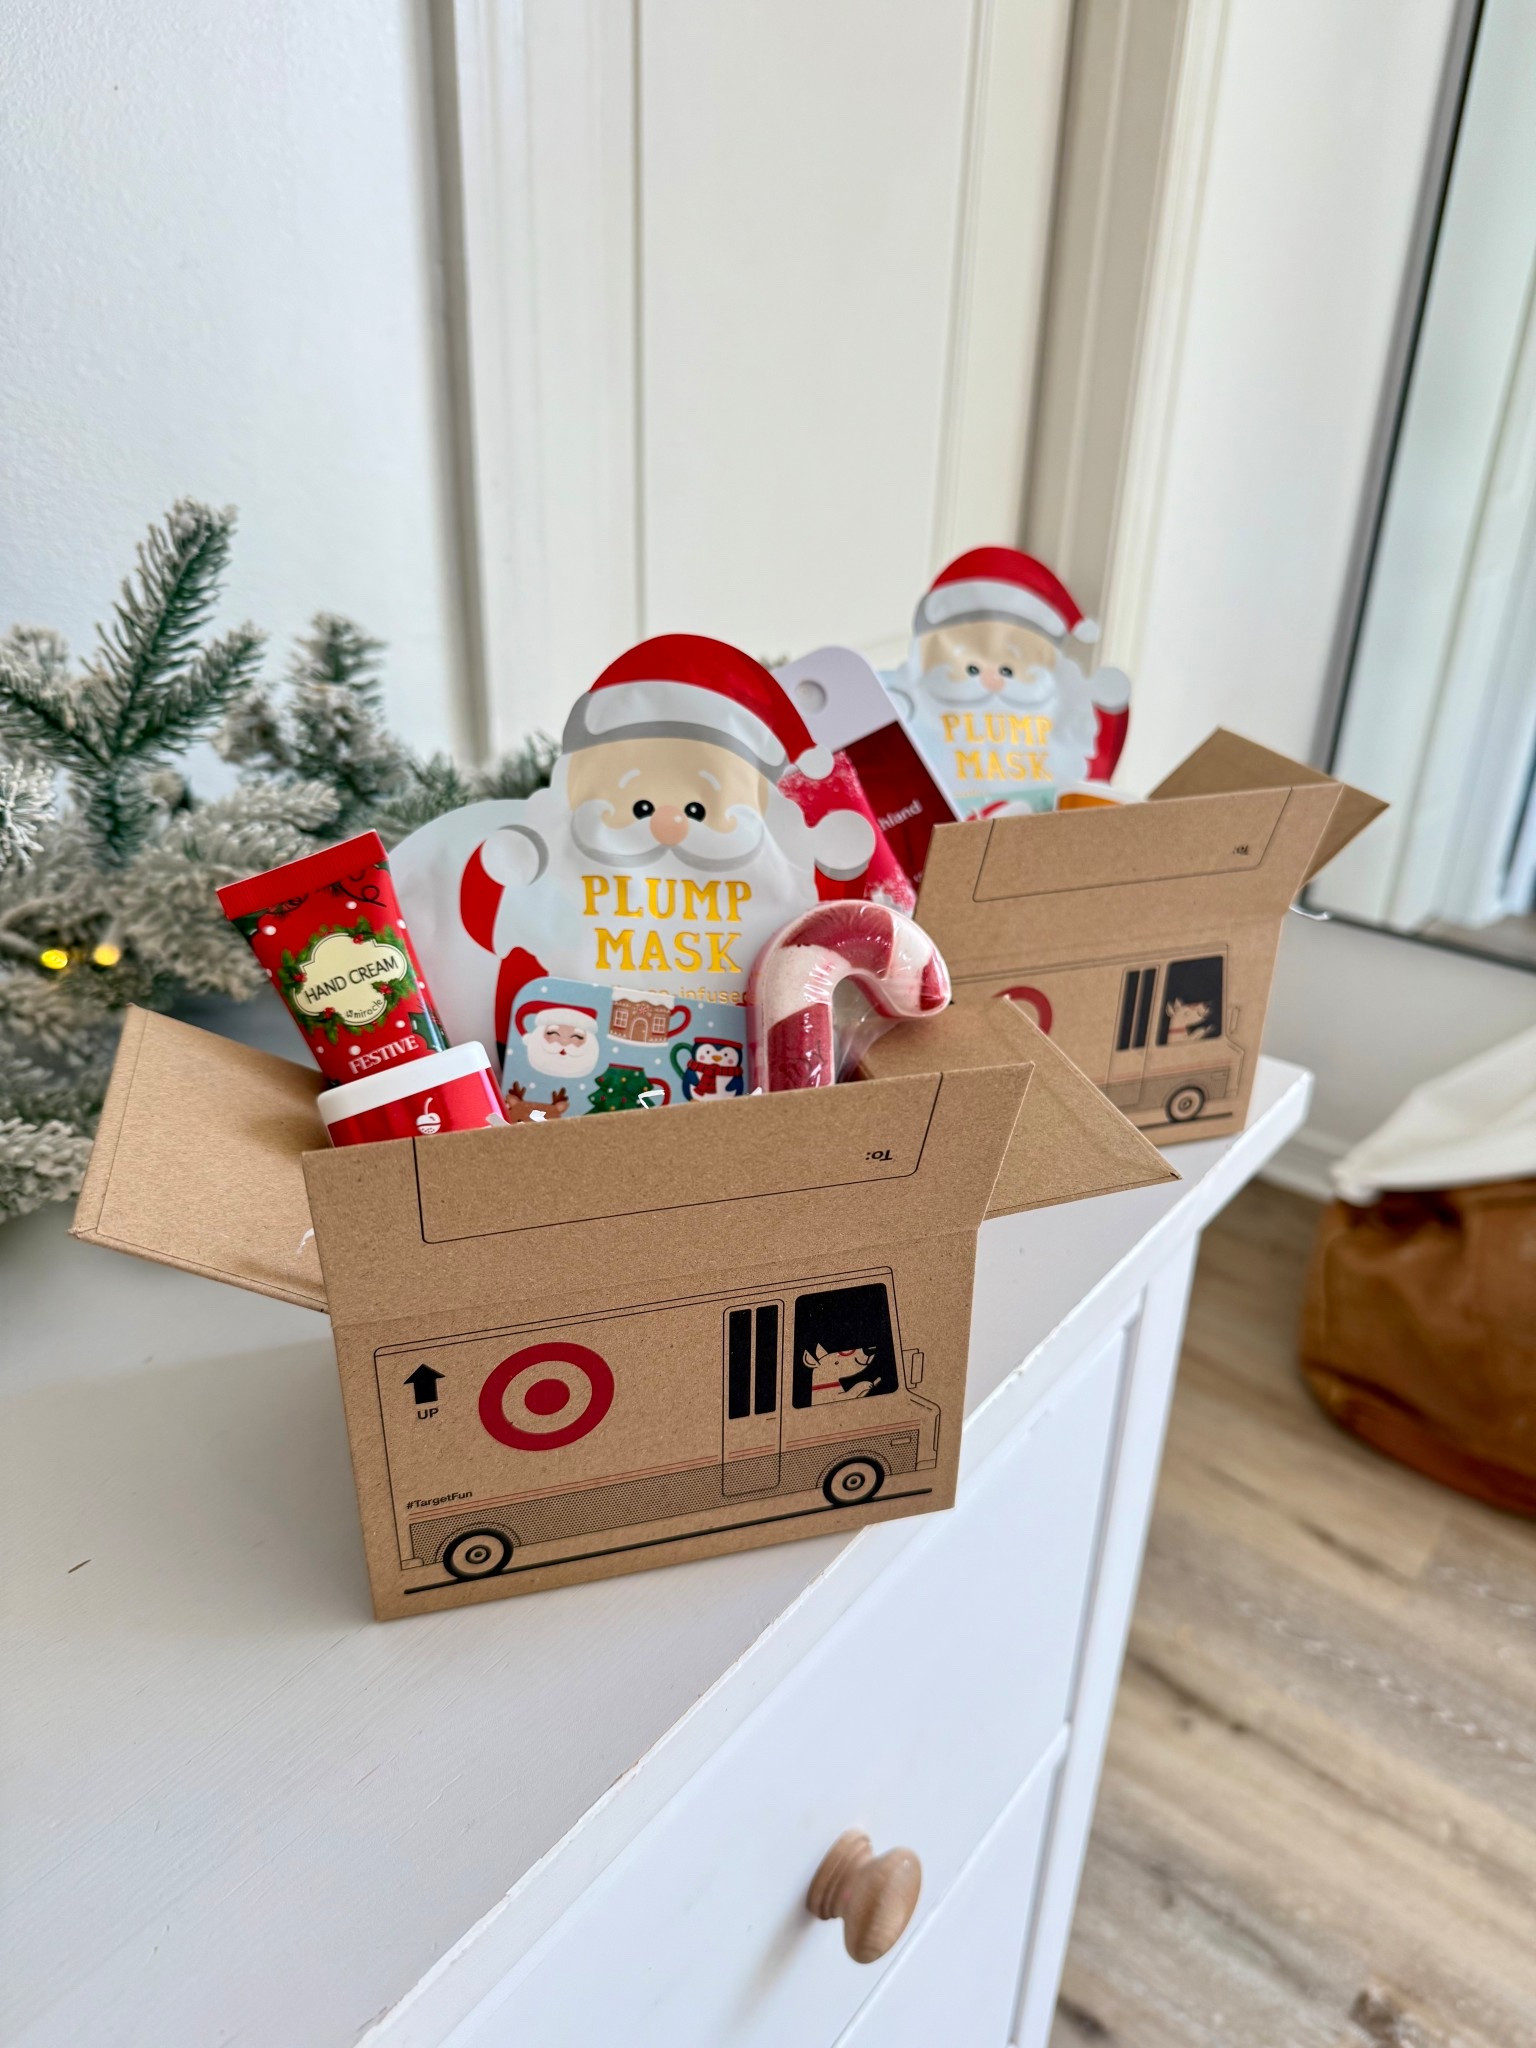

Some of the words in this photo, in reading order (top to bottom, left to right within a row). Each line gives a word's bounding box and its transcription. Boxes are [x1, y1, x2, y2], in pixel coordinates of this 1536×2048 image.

[942, 712, 1053, 746] PLUMP
[955, 749, 1053, 781] MASK
[581, 875, 752, 922] PLUMP
[594, 928, 743, 973] MASK
[304, 976, 347, 1004] HAND
[349, 956, 399, 984] CREAM
[348, 1035, 419, 1074] FESTIVE
[865, 1150, 893, 1161] To:
[417, 1408, 439, 1420] UP
[406, 1491, 473, 1509] #TargetFun
